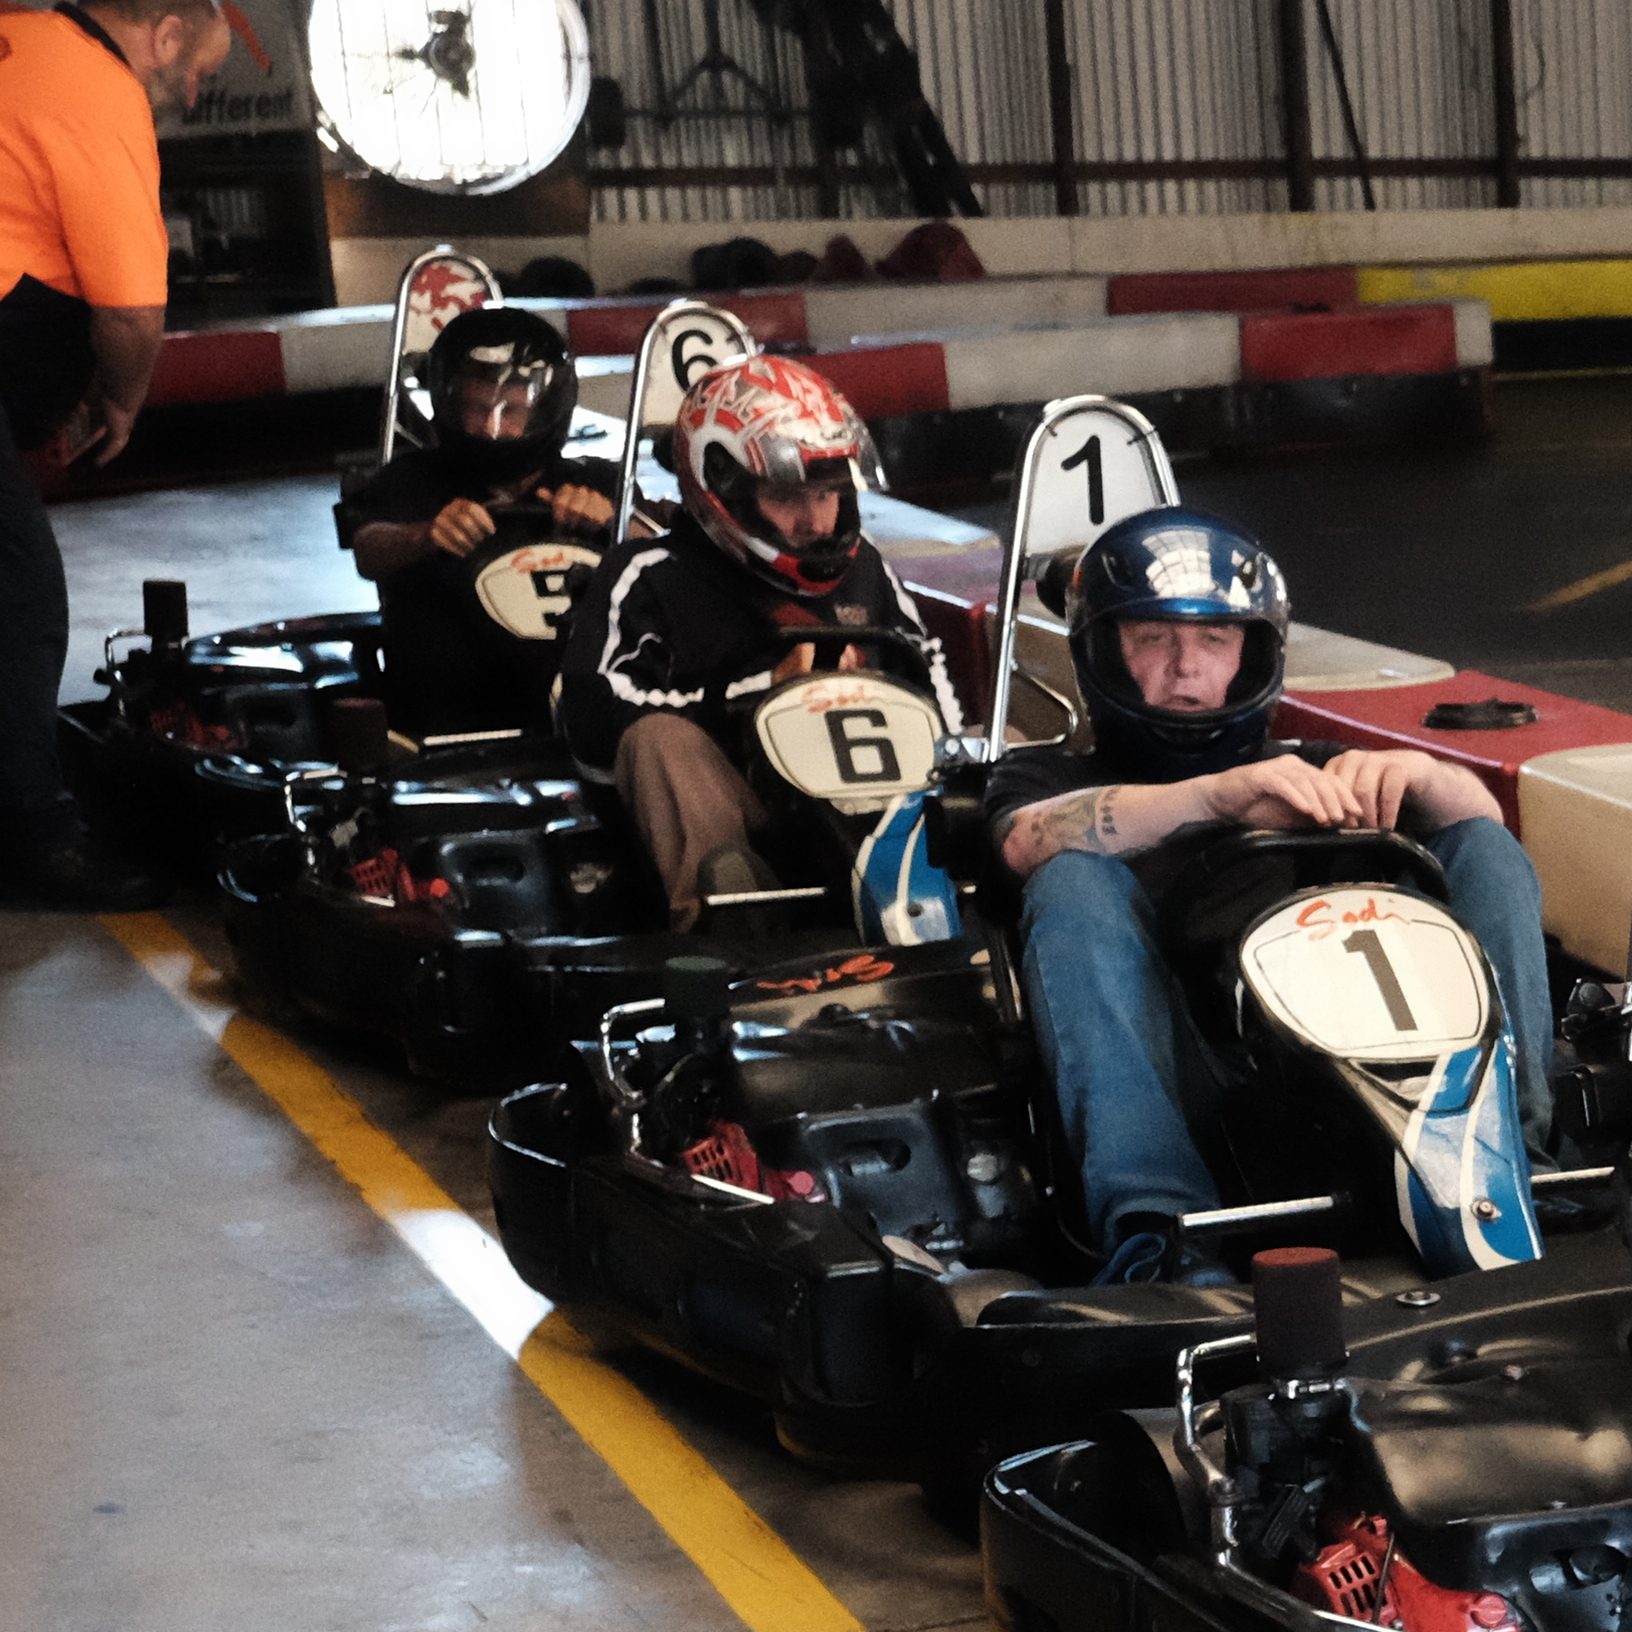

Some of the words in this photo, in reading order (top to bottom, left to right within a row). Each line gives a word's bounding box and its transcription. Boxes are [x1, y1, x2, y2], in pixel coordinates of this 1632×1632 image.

[671, 329, 718, 392] 6
[1060, 434, 1105, 525] 1
[825, 708, 902, 784] 6
[1341, 929, 1419, 1031] 1
